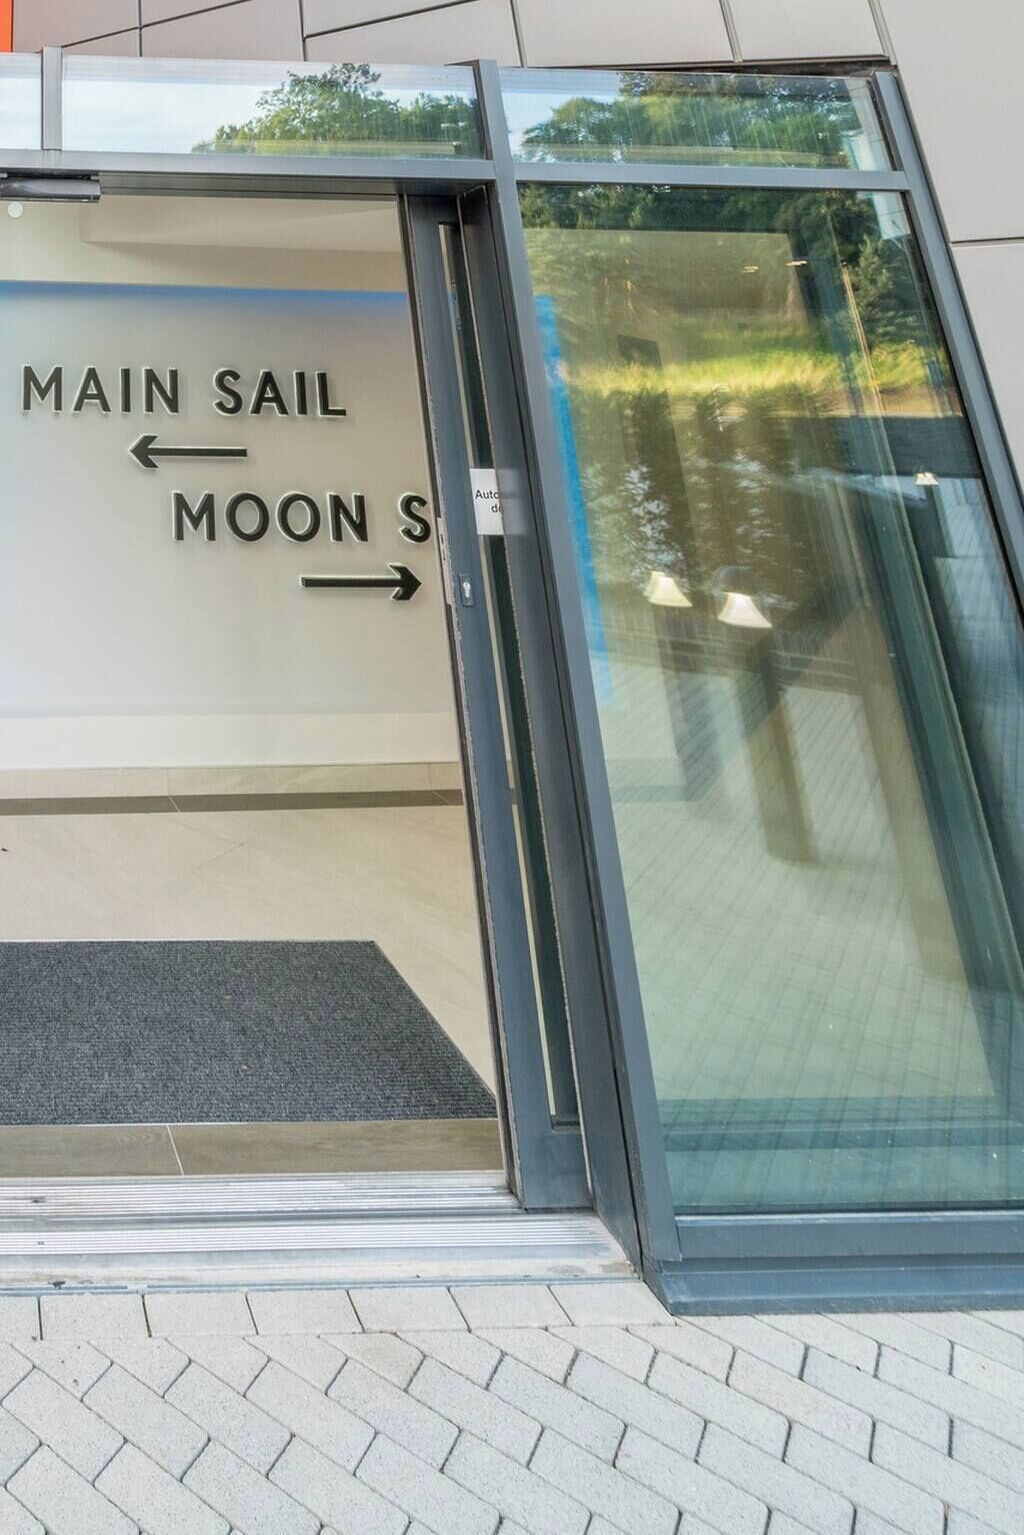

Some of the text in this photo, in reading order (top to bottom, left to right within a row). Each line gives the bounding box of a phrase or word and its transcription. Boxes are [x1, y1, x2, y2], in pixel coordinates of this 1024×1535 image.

[21, 364, 347, 418] MAIN SAIL
[172, 490, 432, 545] MOON S
